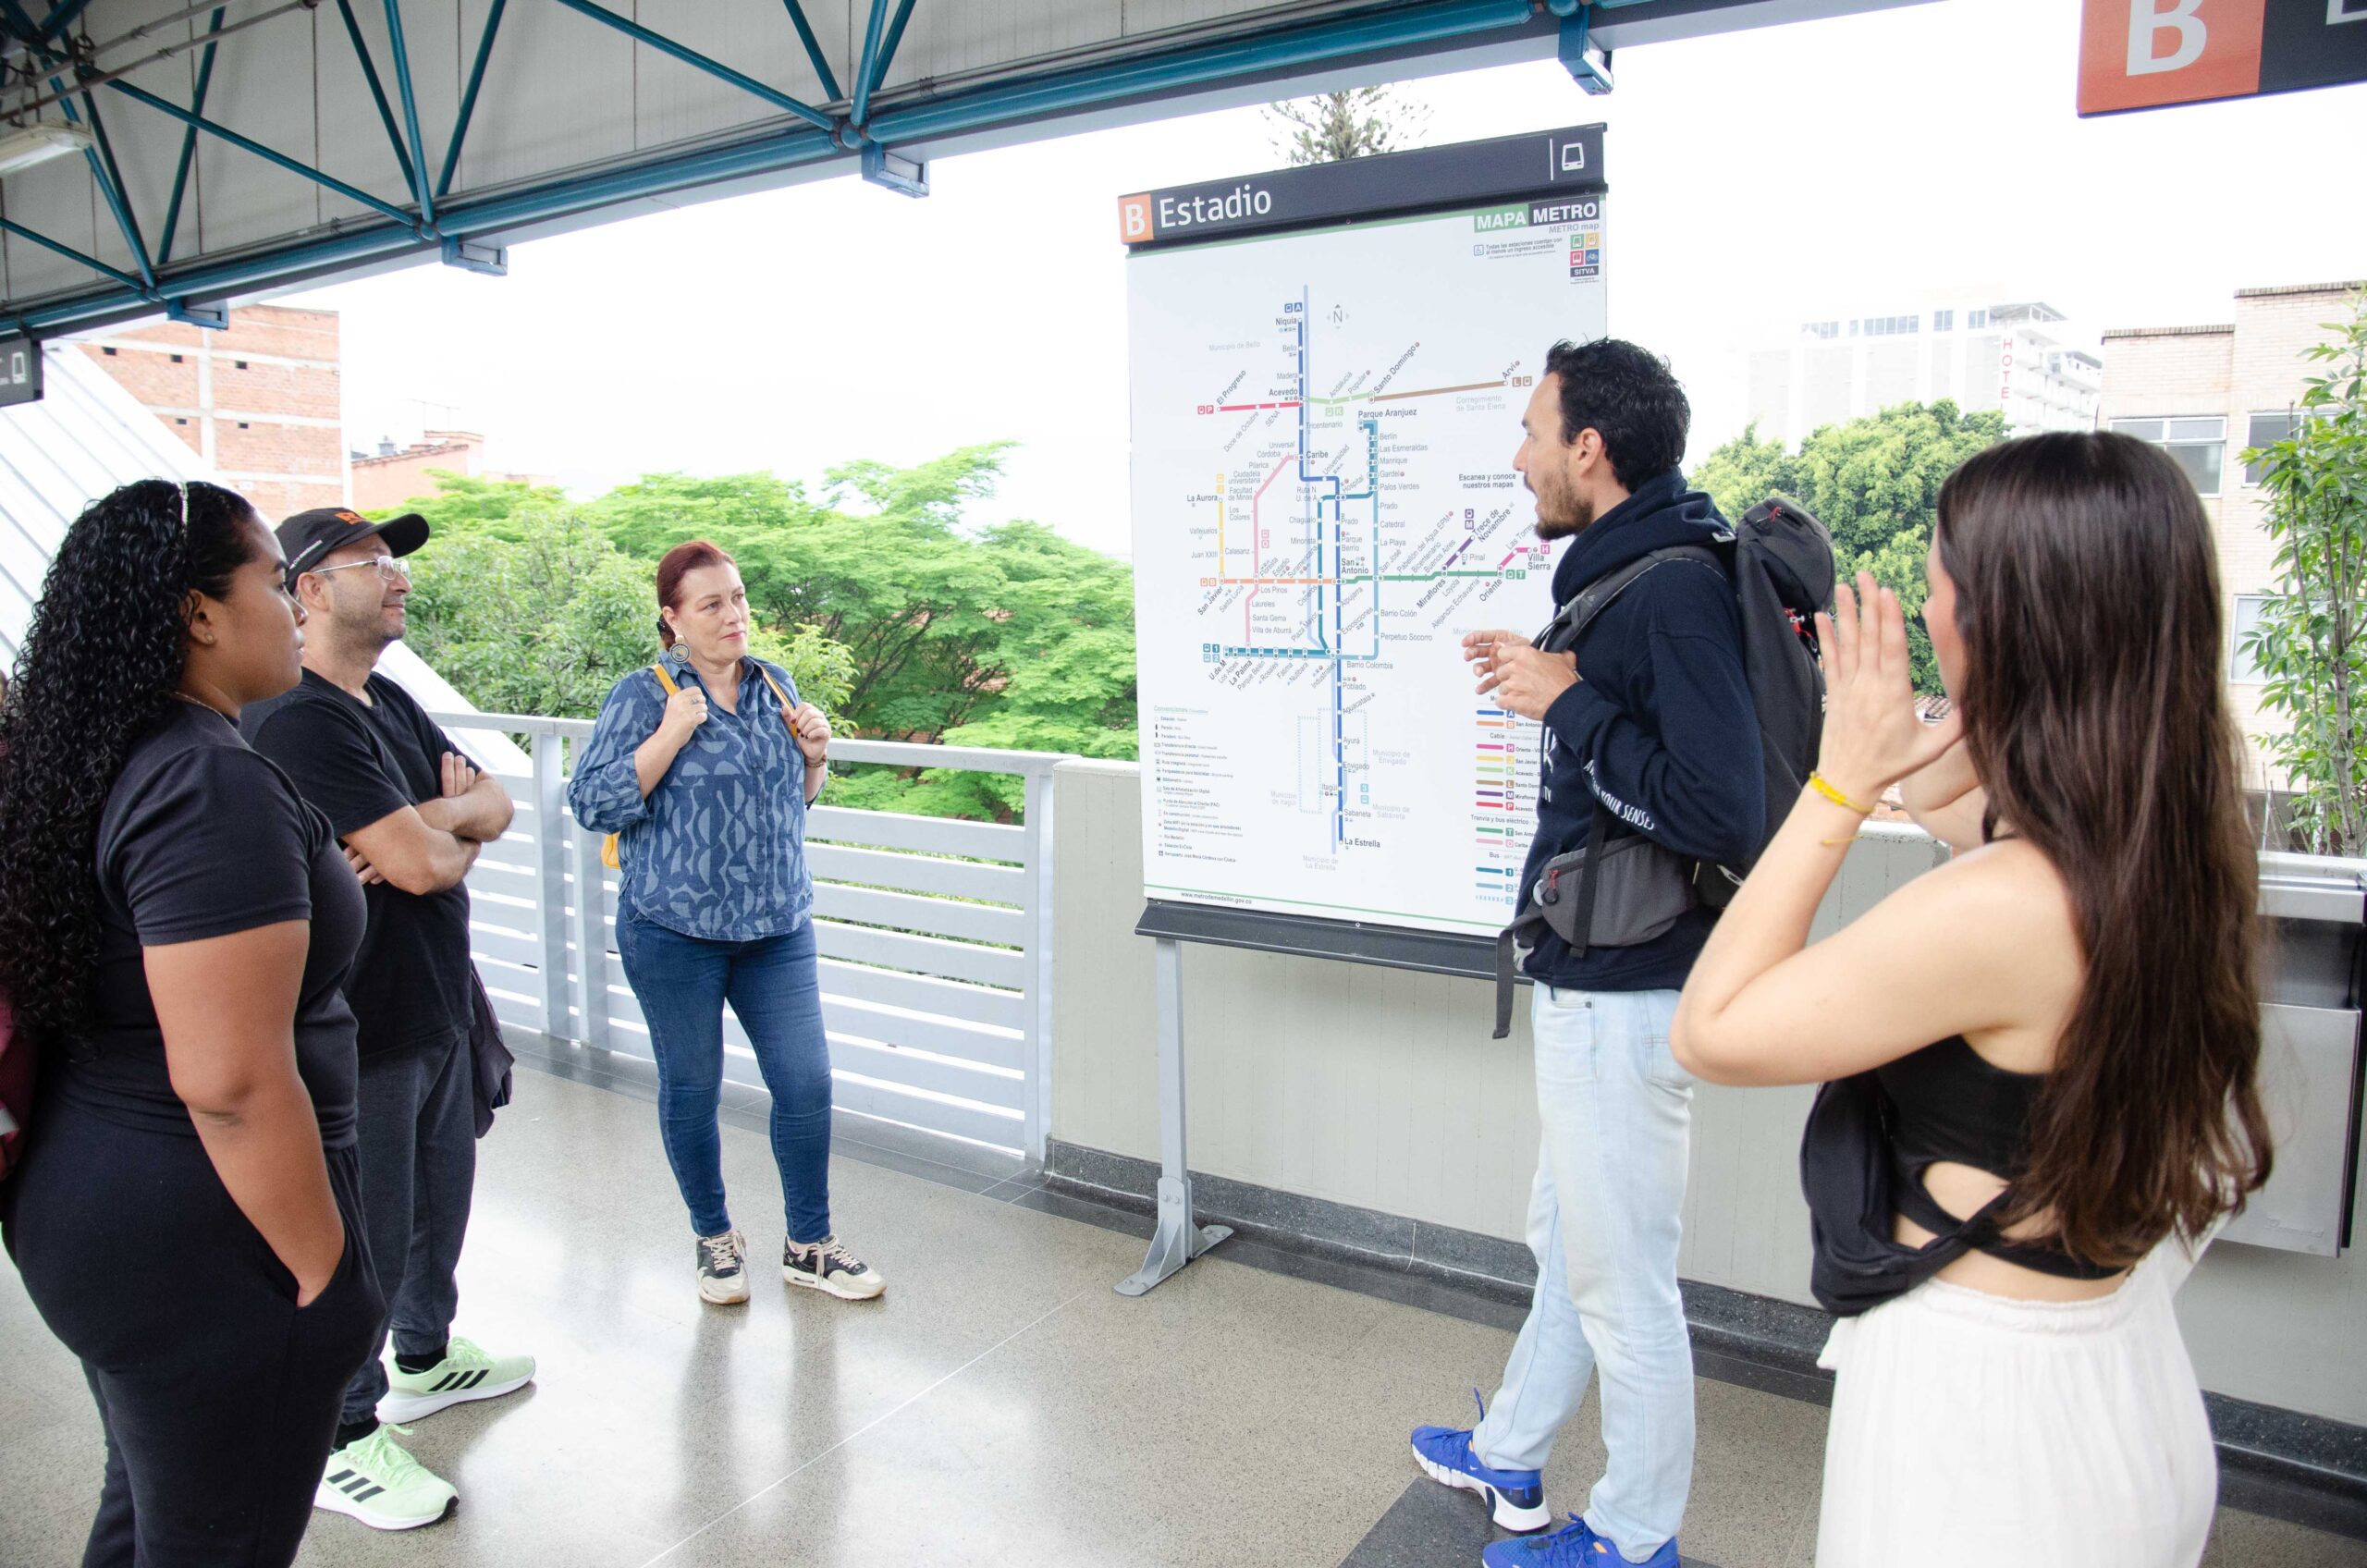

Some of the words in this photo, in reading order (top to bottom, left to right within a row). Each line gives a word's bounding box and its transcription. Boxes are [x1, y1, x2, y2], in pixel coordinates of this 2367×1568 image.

[2126, 0, 2208, 77] B
[1125, 203, 1146, 237] B
[1159, 184, 1271, 228] Estadio
[1477, 211, 1527, 230] MAPA
[1533, 202, 1597, 224] METRO
[1549, 225, 1579, 234] METRO
[1581, 222, 1600, 231] map
[1575, 267, 1595, 276] SITVA
[1333, 310, 1343, 324] N
[1282, 344, 1297, 352] Bello
[1373, 374, 1392, 394] Santo
[1390, 345, 1417, 375] Domingo
[1277, 372, 1298, 380] Madera
[1222, 370, 1247, 398] Progreso
[1269, 387, 1298, 397] Acevedo
[1358, 410, 1383, 420] Parque
[1385, 408, 1417, 418] Aranjuez
[1306, 421, 1343, 430] Tricentenario
[1380, 445, 1391, 453] Las
[1392, 443, 1429, 452] Esmeraldas
[1306, 450, 1329, 459] Caribe
[1380, 457, 1408, 466] Manrique
[1380, 470, 1400, 478] Gardel
[1459, 473, 1486, 482] Escanea
[1492, 472, 1516, 481] conoce
[1492, 481, 1514, 489] mapas
[1196, 494, 1218, 502] Aurora
[1380, 502, 1398, 510] Prado
[1380, 520, 1405, 529] Catedral
[1472, 516, 1492, 536] Trece
[1478, 508, 1512, 543] Noviembre
[1342, 557, 1355, 566] San
[1527, 553, 1545, 562] Villa
[1342, 566, 1369, 574] Antonio
[1527, 561, 1551, 570] Sierra
[1416, 578, 1446, 608] Miraflores
[1479, 578, 1502, 602] Oriente
[1234, 660, 1253, 679] Palma
[1344, 837, 1353, 845] La
[1355, 838, 1380, 848] Estrella
